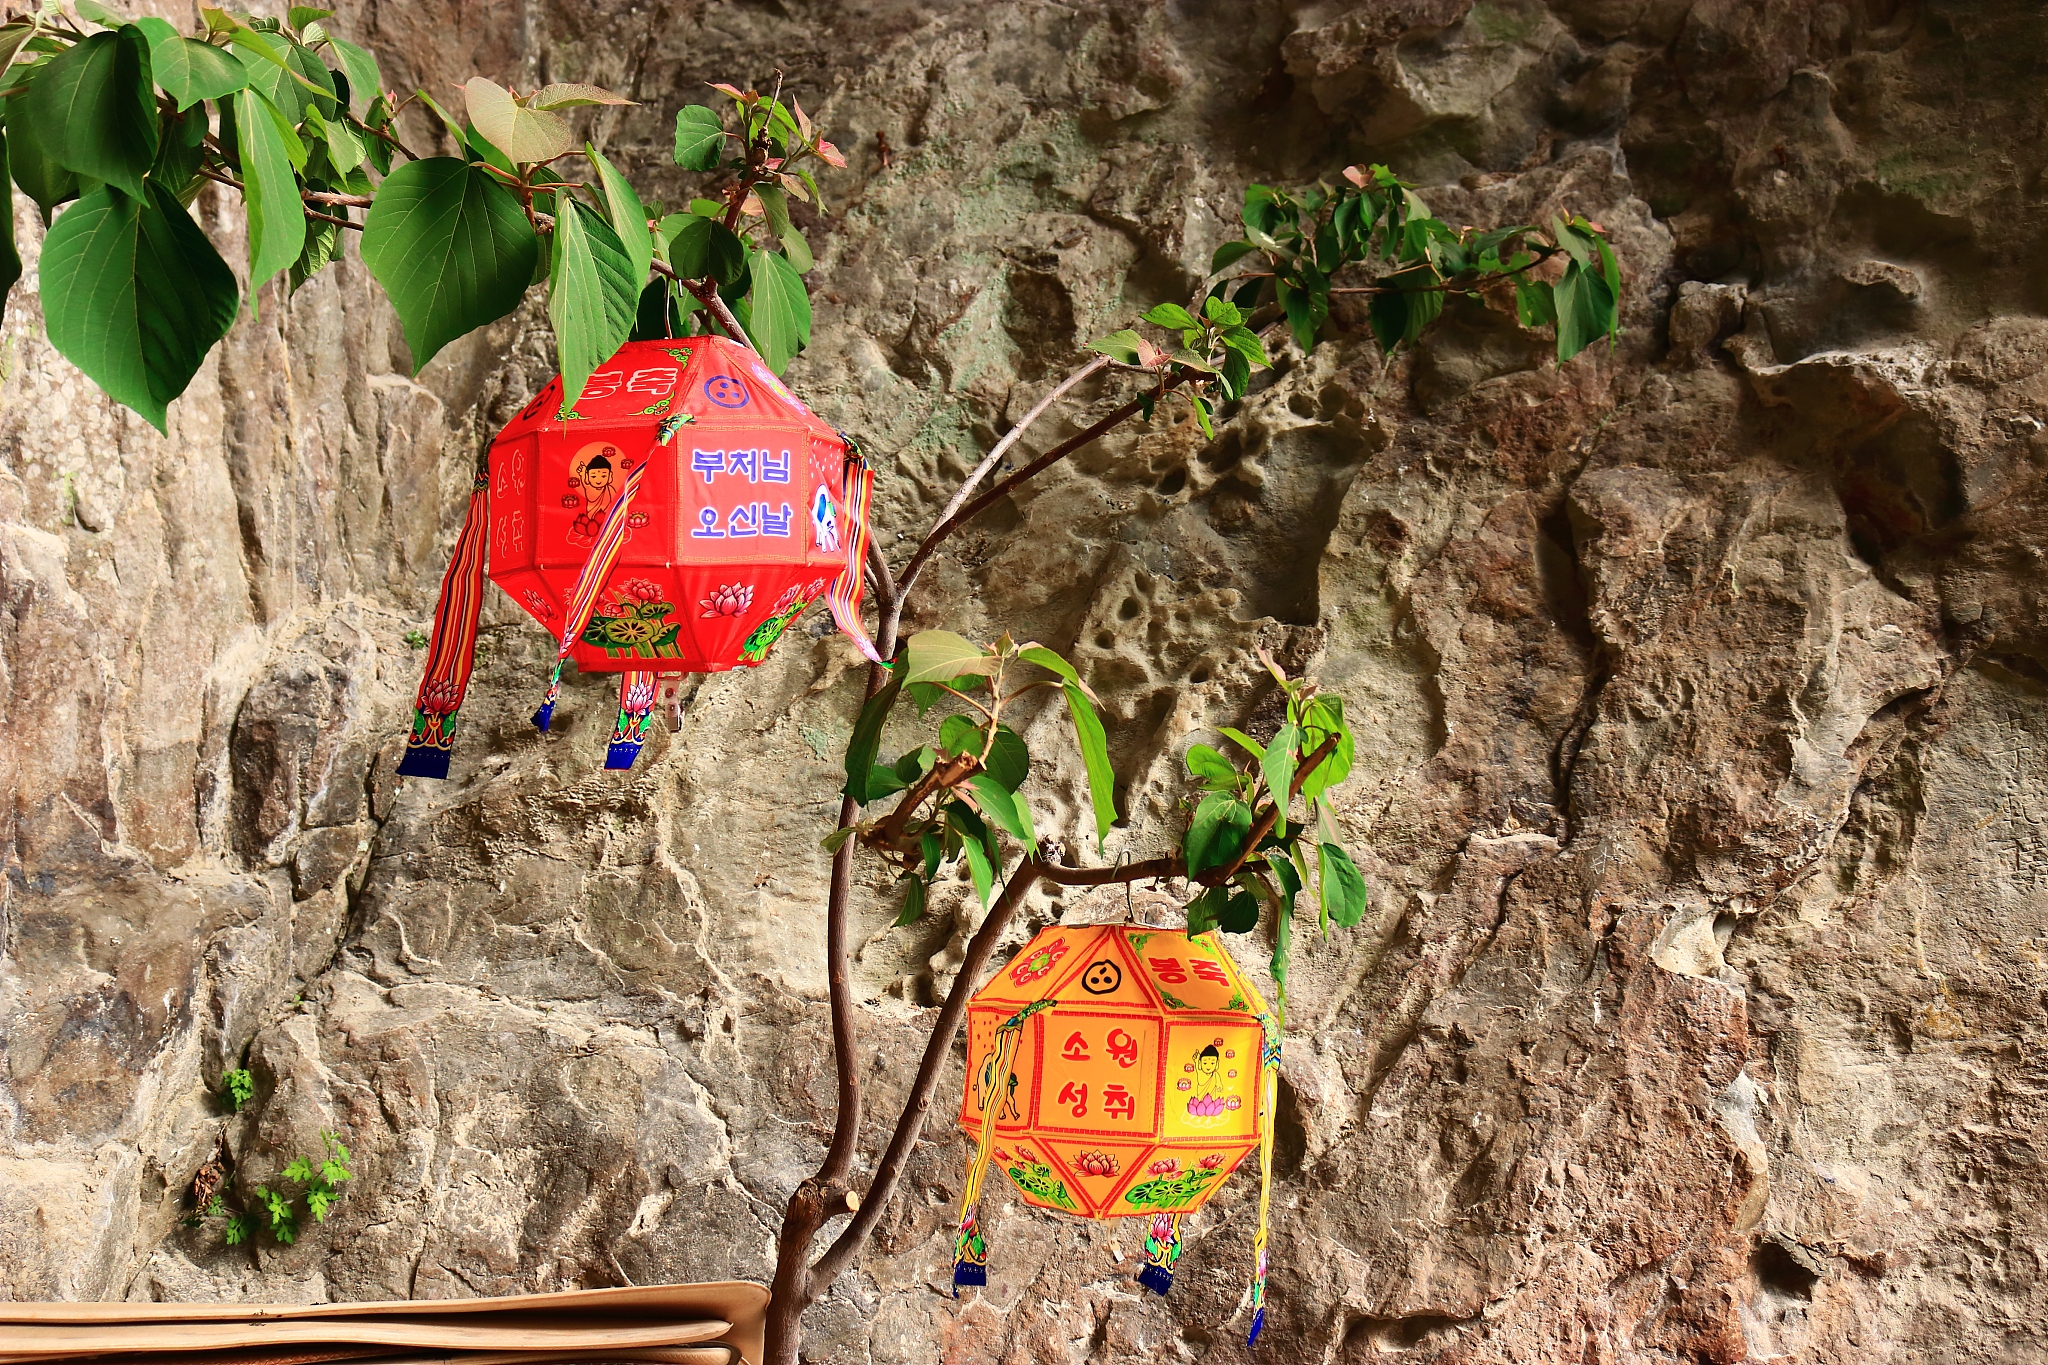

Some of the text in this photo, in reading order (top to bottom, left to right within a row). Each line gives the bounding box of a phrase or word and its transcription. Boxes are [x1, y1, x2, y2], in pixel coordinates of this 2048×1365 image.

[691, 448, 791, 483] 부처님
[691, 502, 793, 539] 오신날
[1148, 955, 1230, 988] 봉축
[1060, 1028, 1138, 1069] 소원
[1057, 1080, 1136, 1121] 성취
